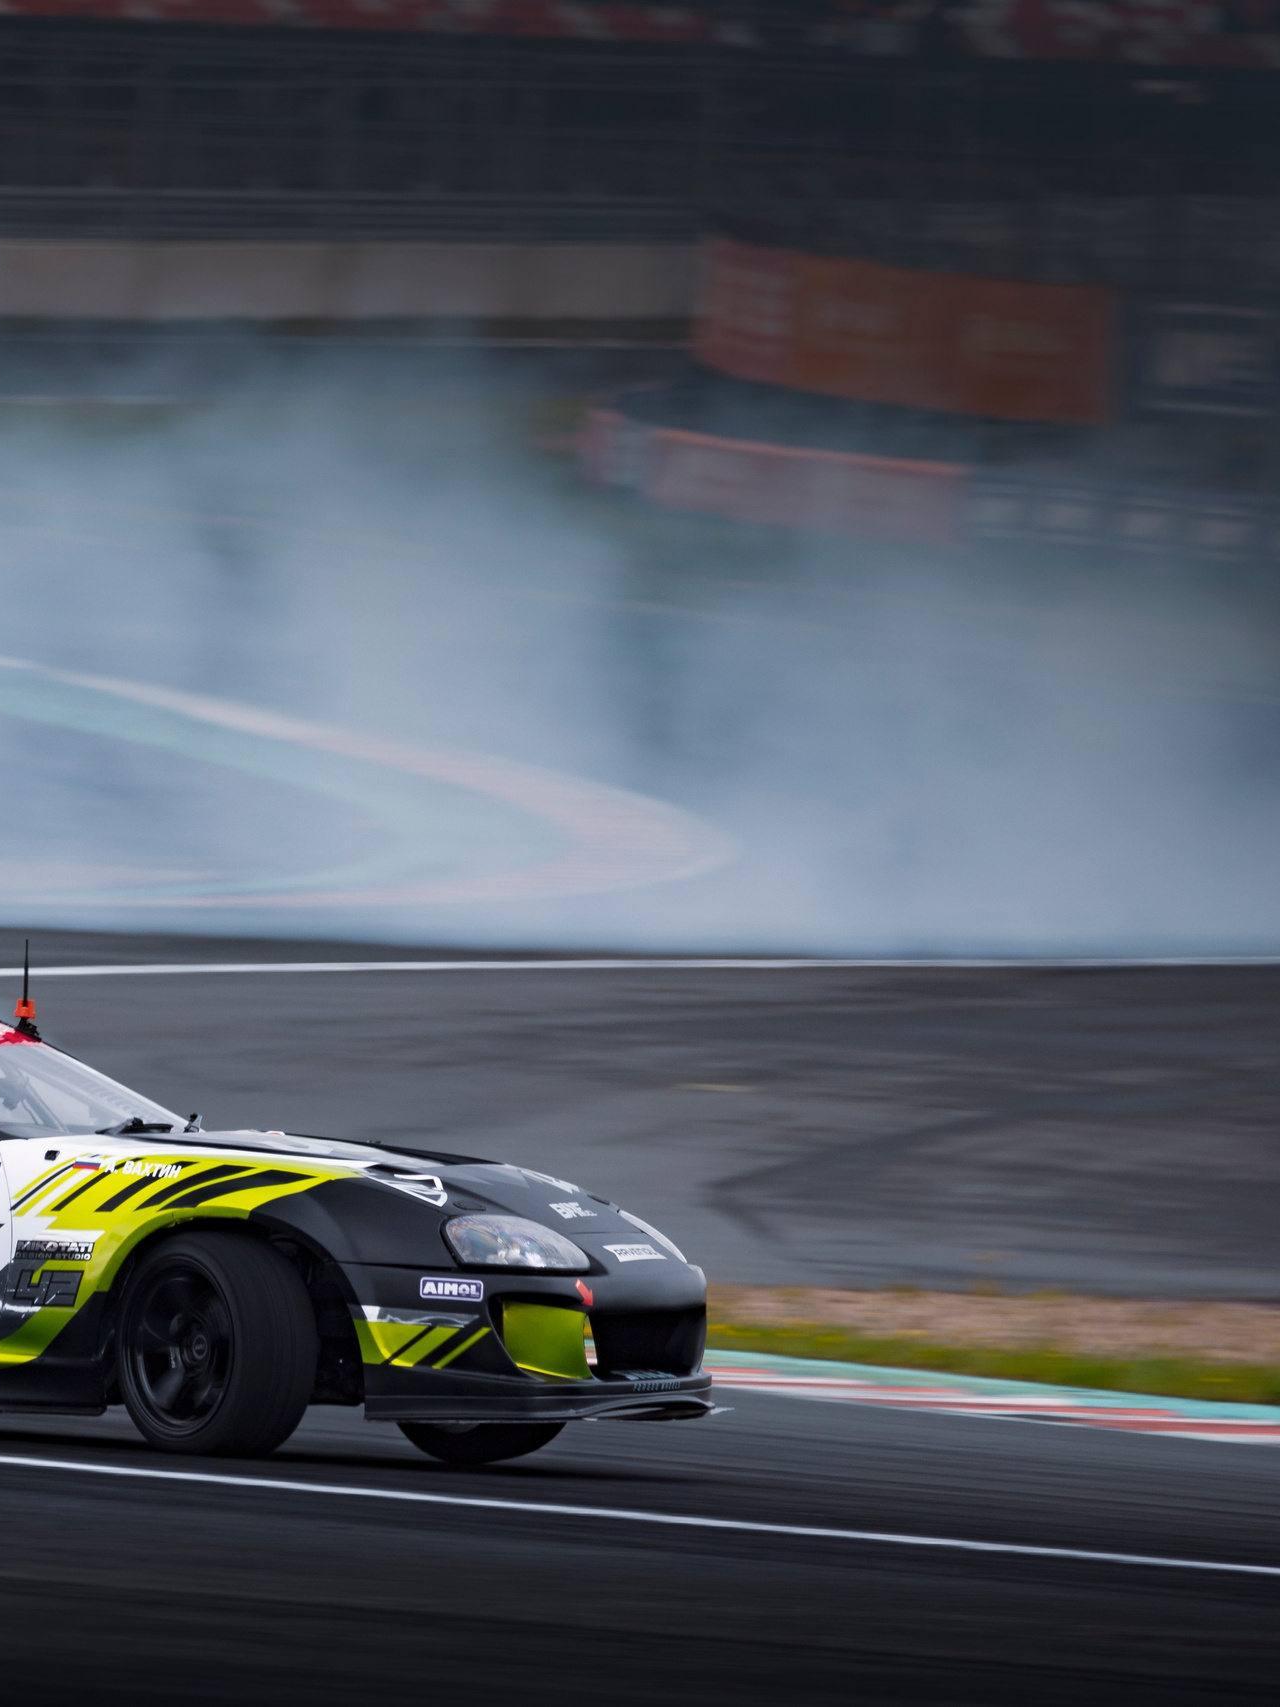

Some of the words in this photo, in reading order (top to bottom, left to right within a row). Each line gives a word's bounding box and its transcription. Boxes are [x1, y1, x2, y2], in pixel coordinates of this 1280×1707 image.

[122, 1160, 182, 1179] ВАХТИН
[17, 1241, 95, 1253] MIKOTATI
[15, 1252, 53, 1260] DESIGN
[55, 1253, 92, 1261] STUDIO
[422, 1281, 480, 1298] AIMOL
